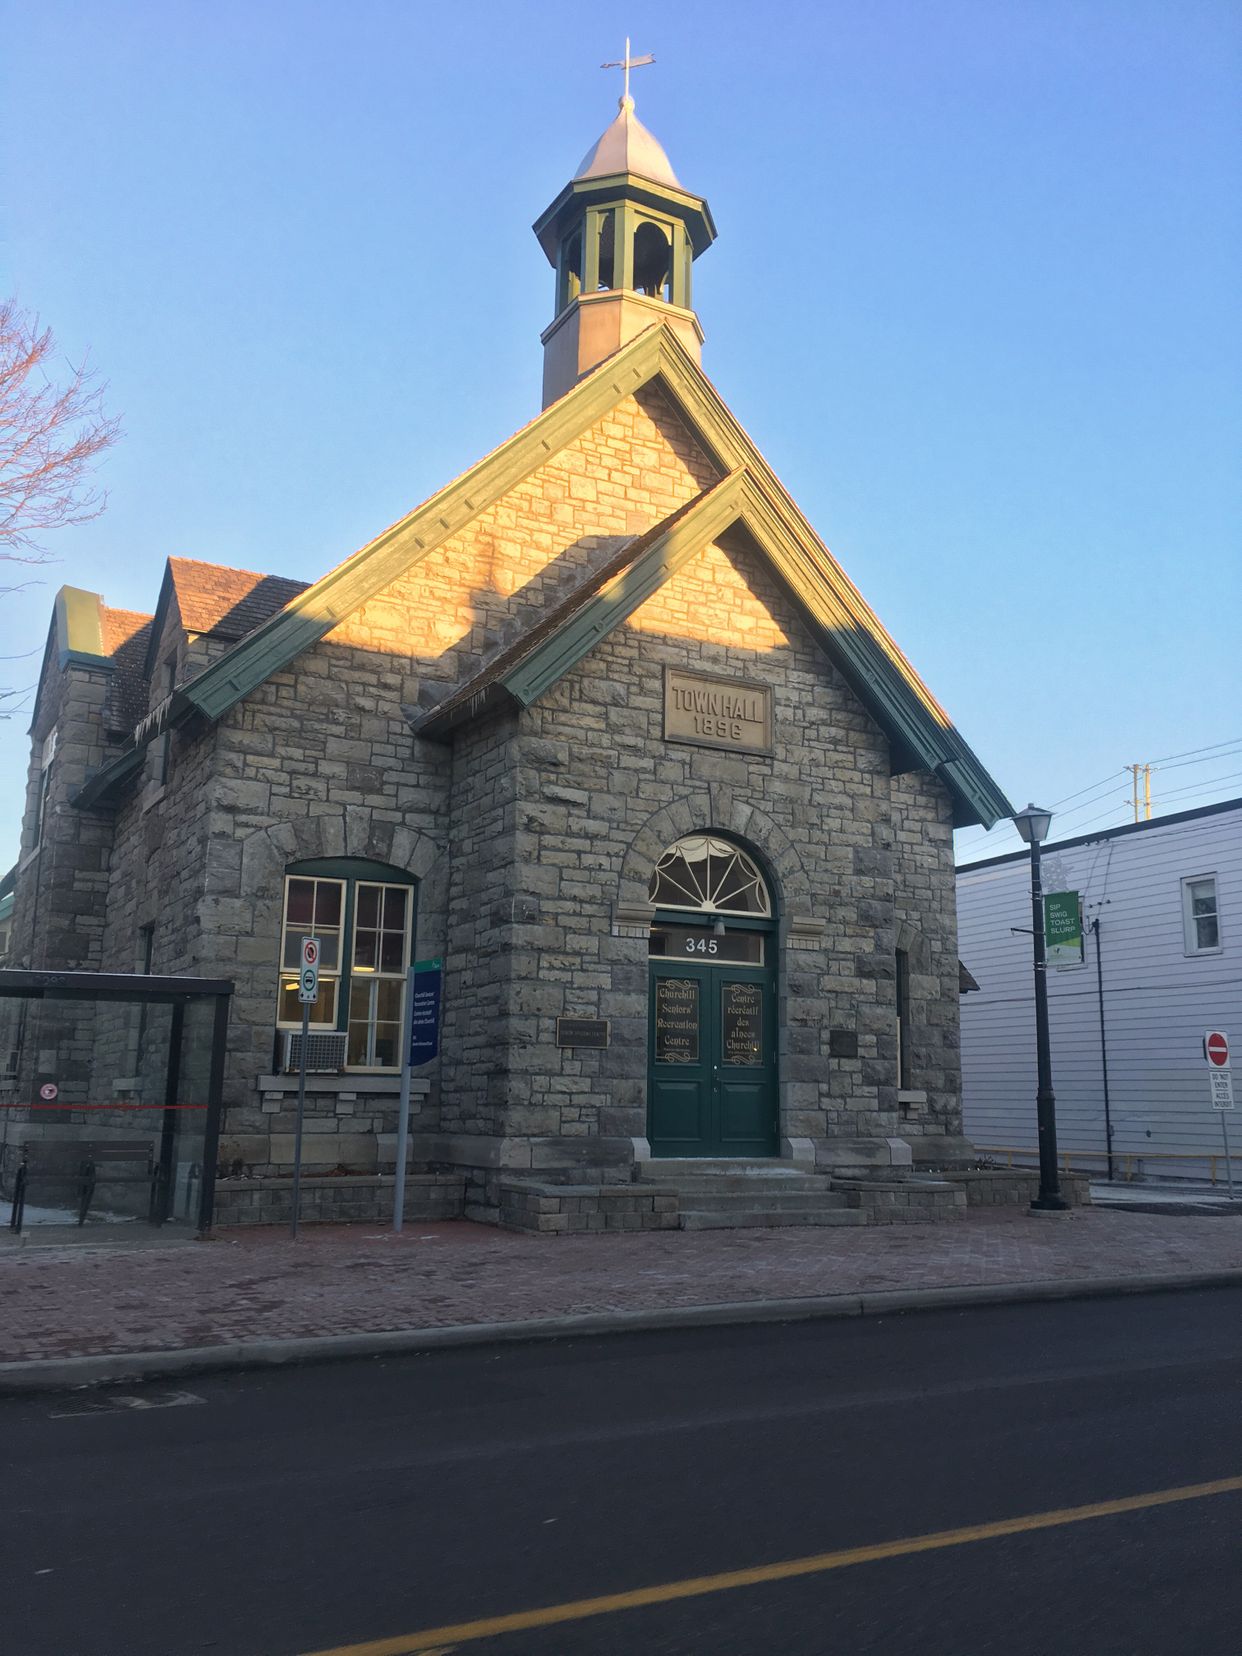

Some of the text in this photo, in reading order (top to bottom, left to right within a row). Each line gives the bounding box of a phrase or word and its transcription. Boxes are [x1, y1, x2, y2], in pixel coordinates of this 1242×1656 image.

[672, 686, 763, 723] TOWN HALL
[1049, 903, 1061, 911] SIP
[1049, 911, 1068, 919] SWIG
[1050, 918, 1075, 926] TOAST
[1050, 926, 1076, 934] SLURP
[685, 937, 718, 954] 345
[659, 988, 695, 1000] Churchill
[731, 993, 755, 1004] Centre
[657, 1018, 698, 1030] Recreation
[664, 1035, 690, 1046] Centre
[726, 1040, 760, 1051] Churchill
